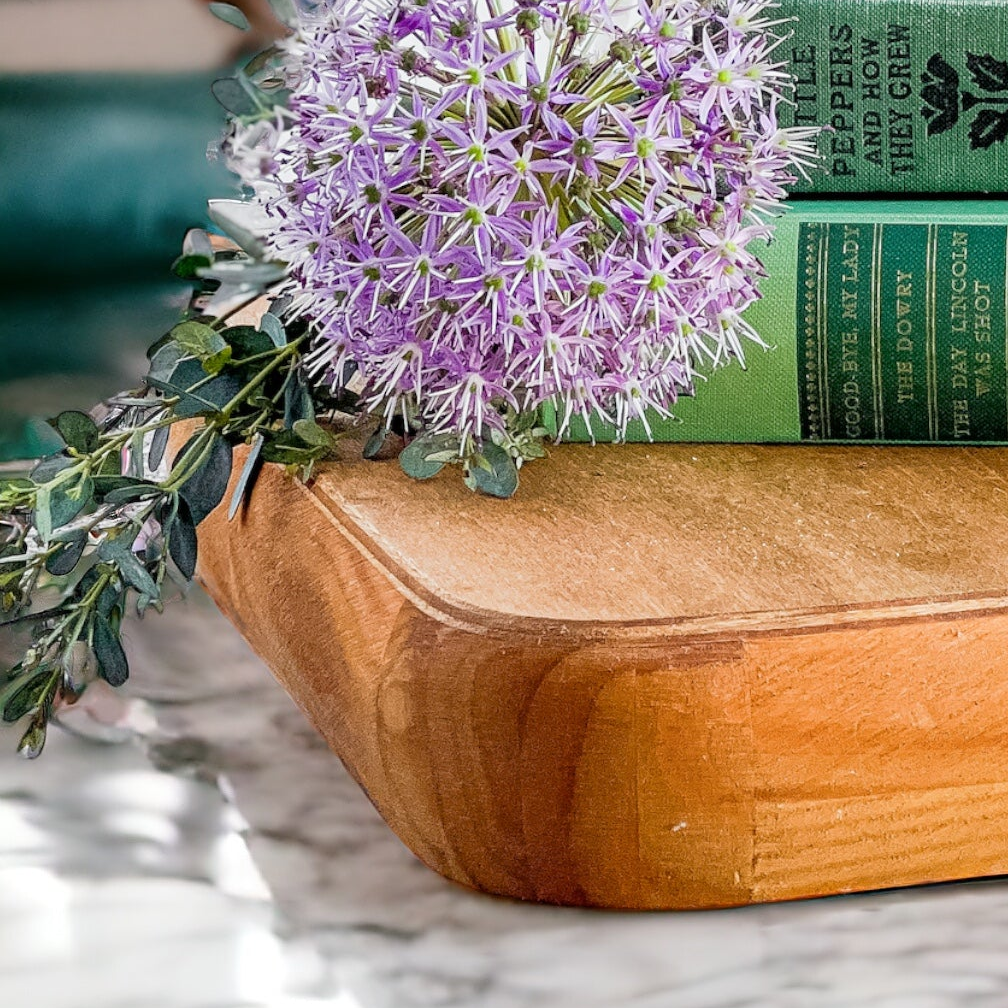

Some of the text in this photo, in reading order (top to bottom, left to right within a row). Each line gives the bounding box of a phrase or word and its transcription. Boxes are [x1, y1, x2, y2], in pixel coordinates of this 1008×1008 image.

[829, 23, 856, 177] PEPPERS
[862, 38, 882, 166] AND HOW
[888, 24, 914, 175] THEY GREW
[841, 225, 860, 283] LADY
[841, 289, 858, 320] MY
[896, 270, 914, 403] THE DOWRY
[951, 231, 971, 438] THE DAY LINCOLN
[974, 280, 992, 397] WAS SHOT
